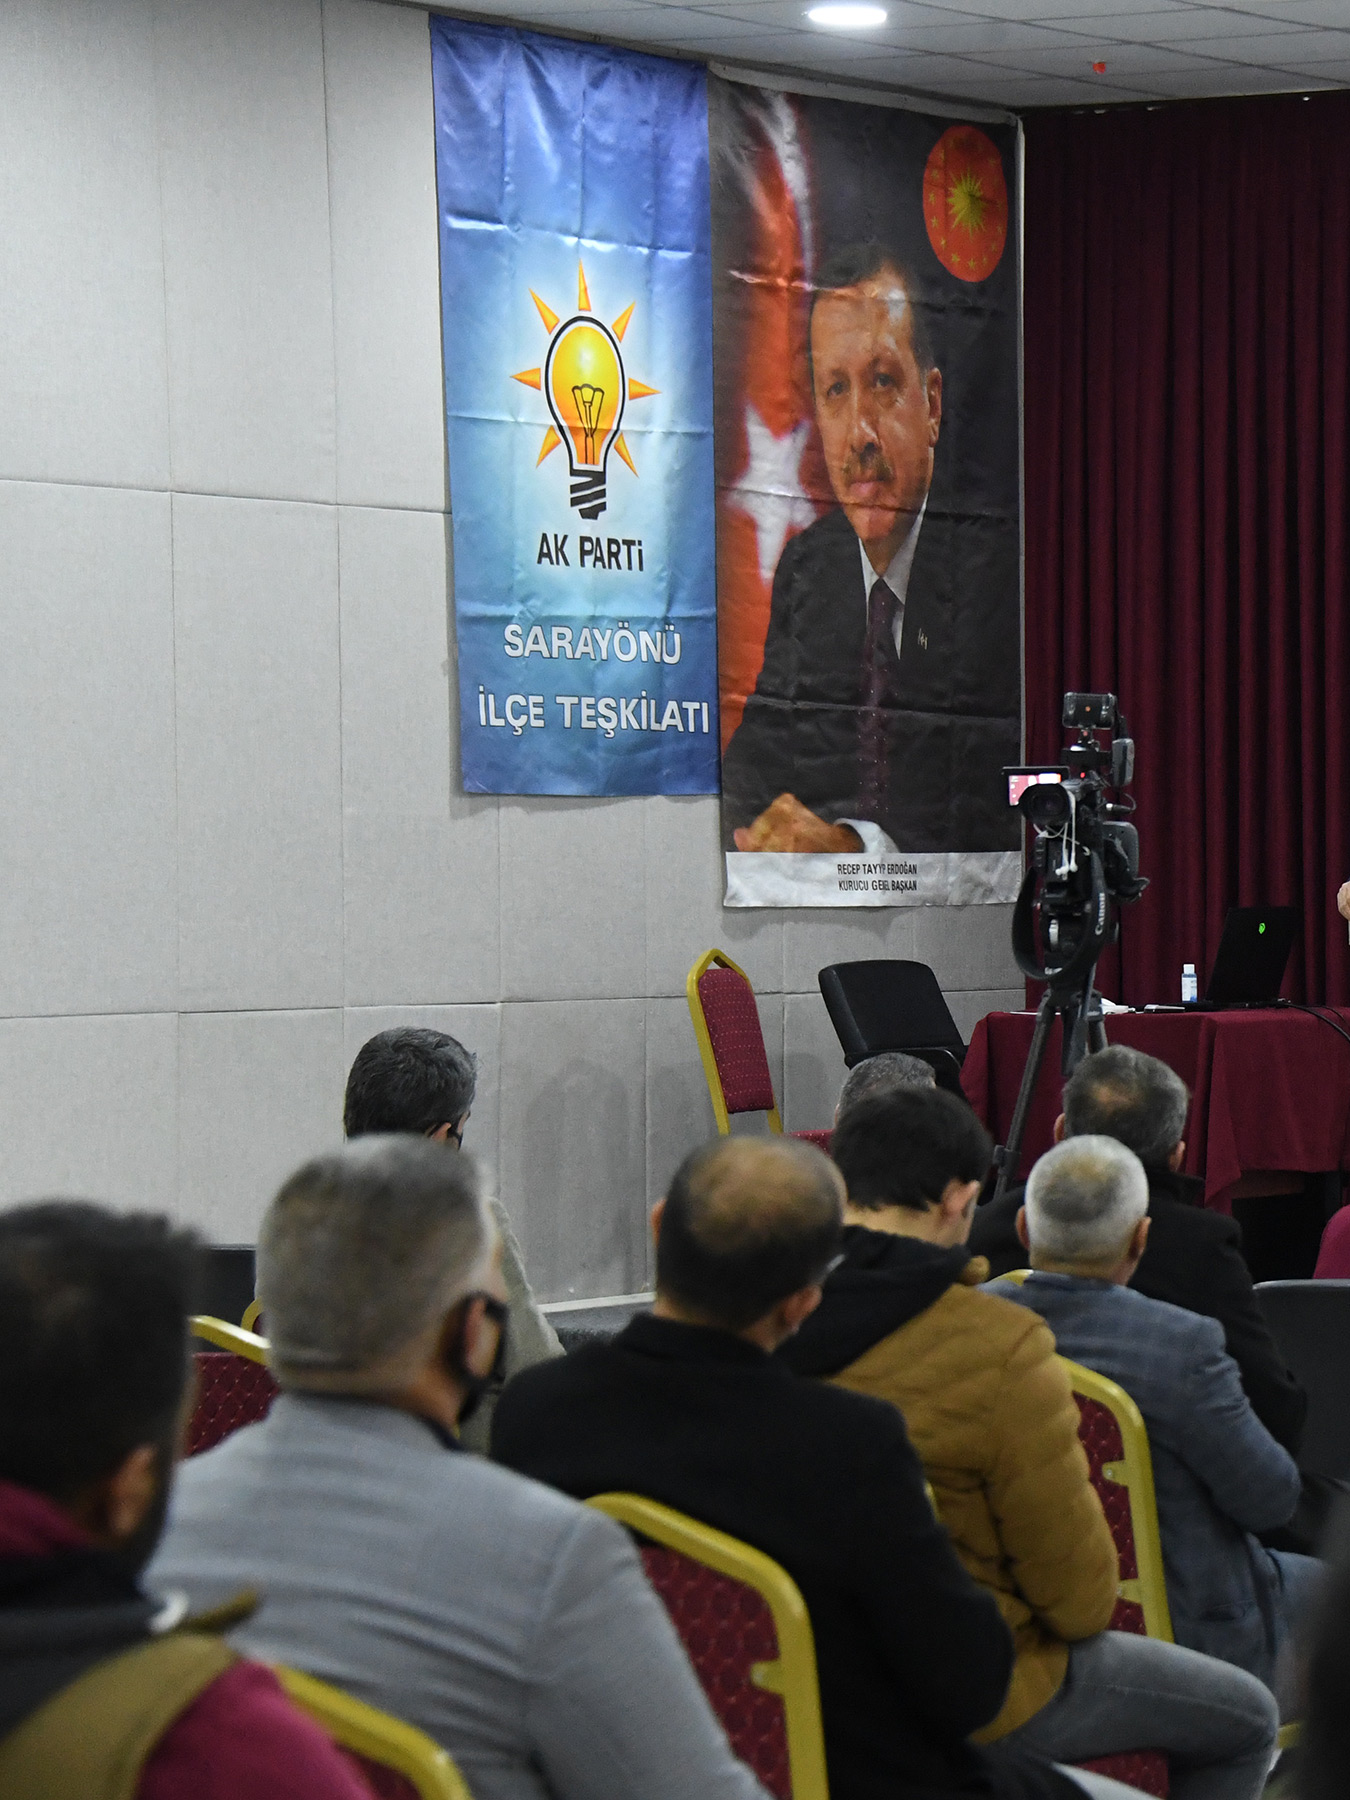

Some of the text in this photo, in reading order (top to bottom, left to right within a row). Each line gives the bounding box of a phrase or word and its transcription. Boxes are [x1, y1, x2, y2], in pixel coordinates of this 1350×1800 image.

[537, 532, 570, 567] AK
[503, 621, 682, 665] SARAYÖNÜ
[478, 685, 709, 737] İLÇE TEŞKİLATI
[837, 864, 860, 875] RECEP
[887, 861, 917, 875] ERDOĞAN
[838, 880, 869, 892] KURUCU
[891, 880, 917, 894] BAŞKAN
[1095, 892, 1106, 935] Canon
